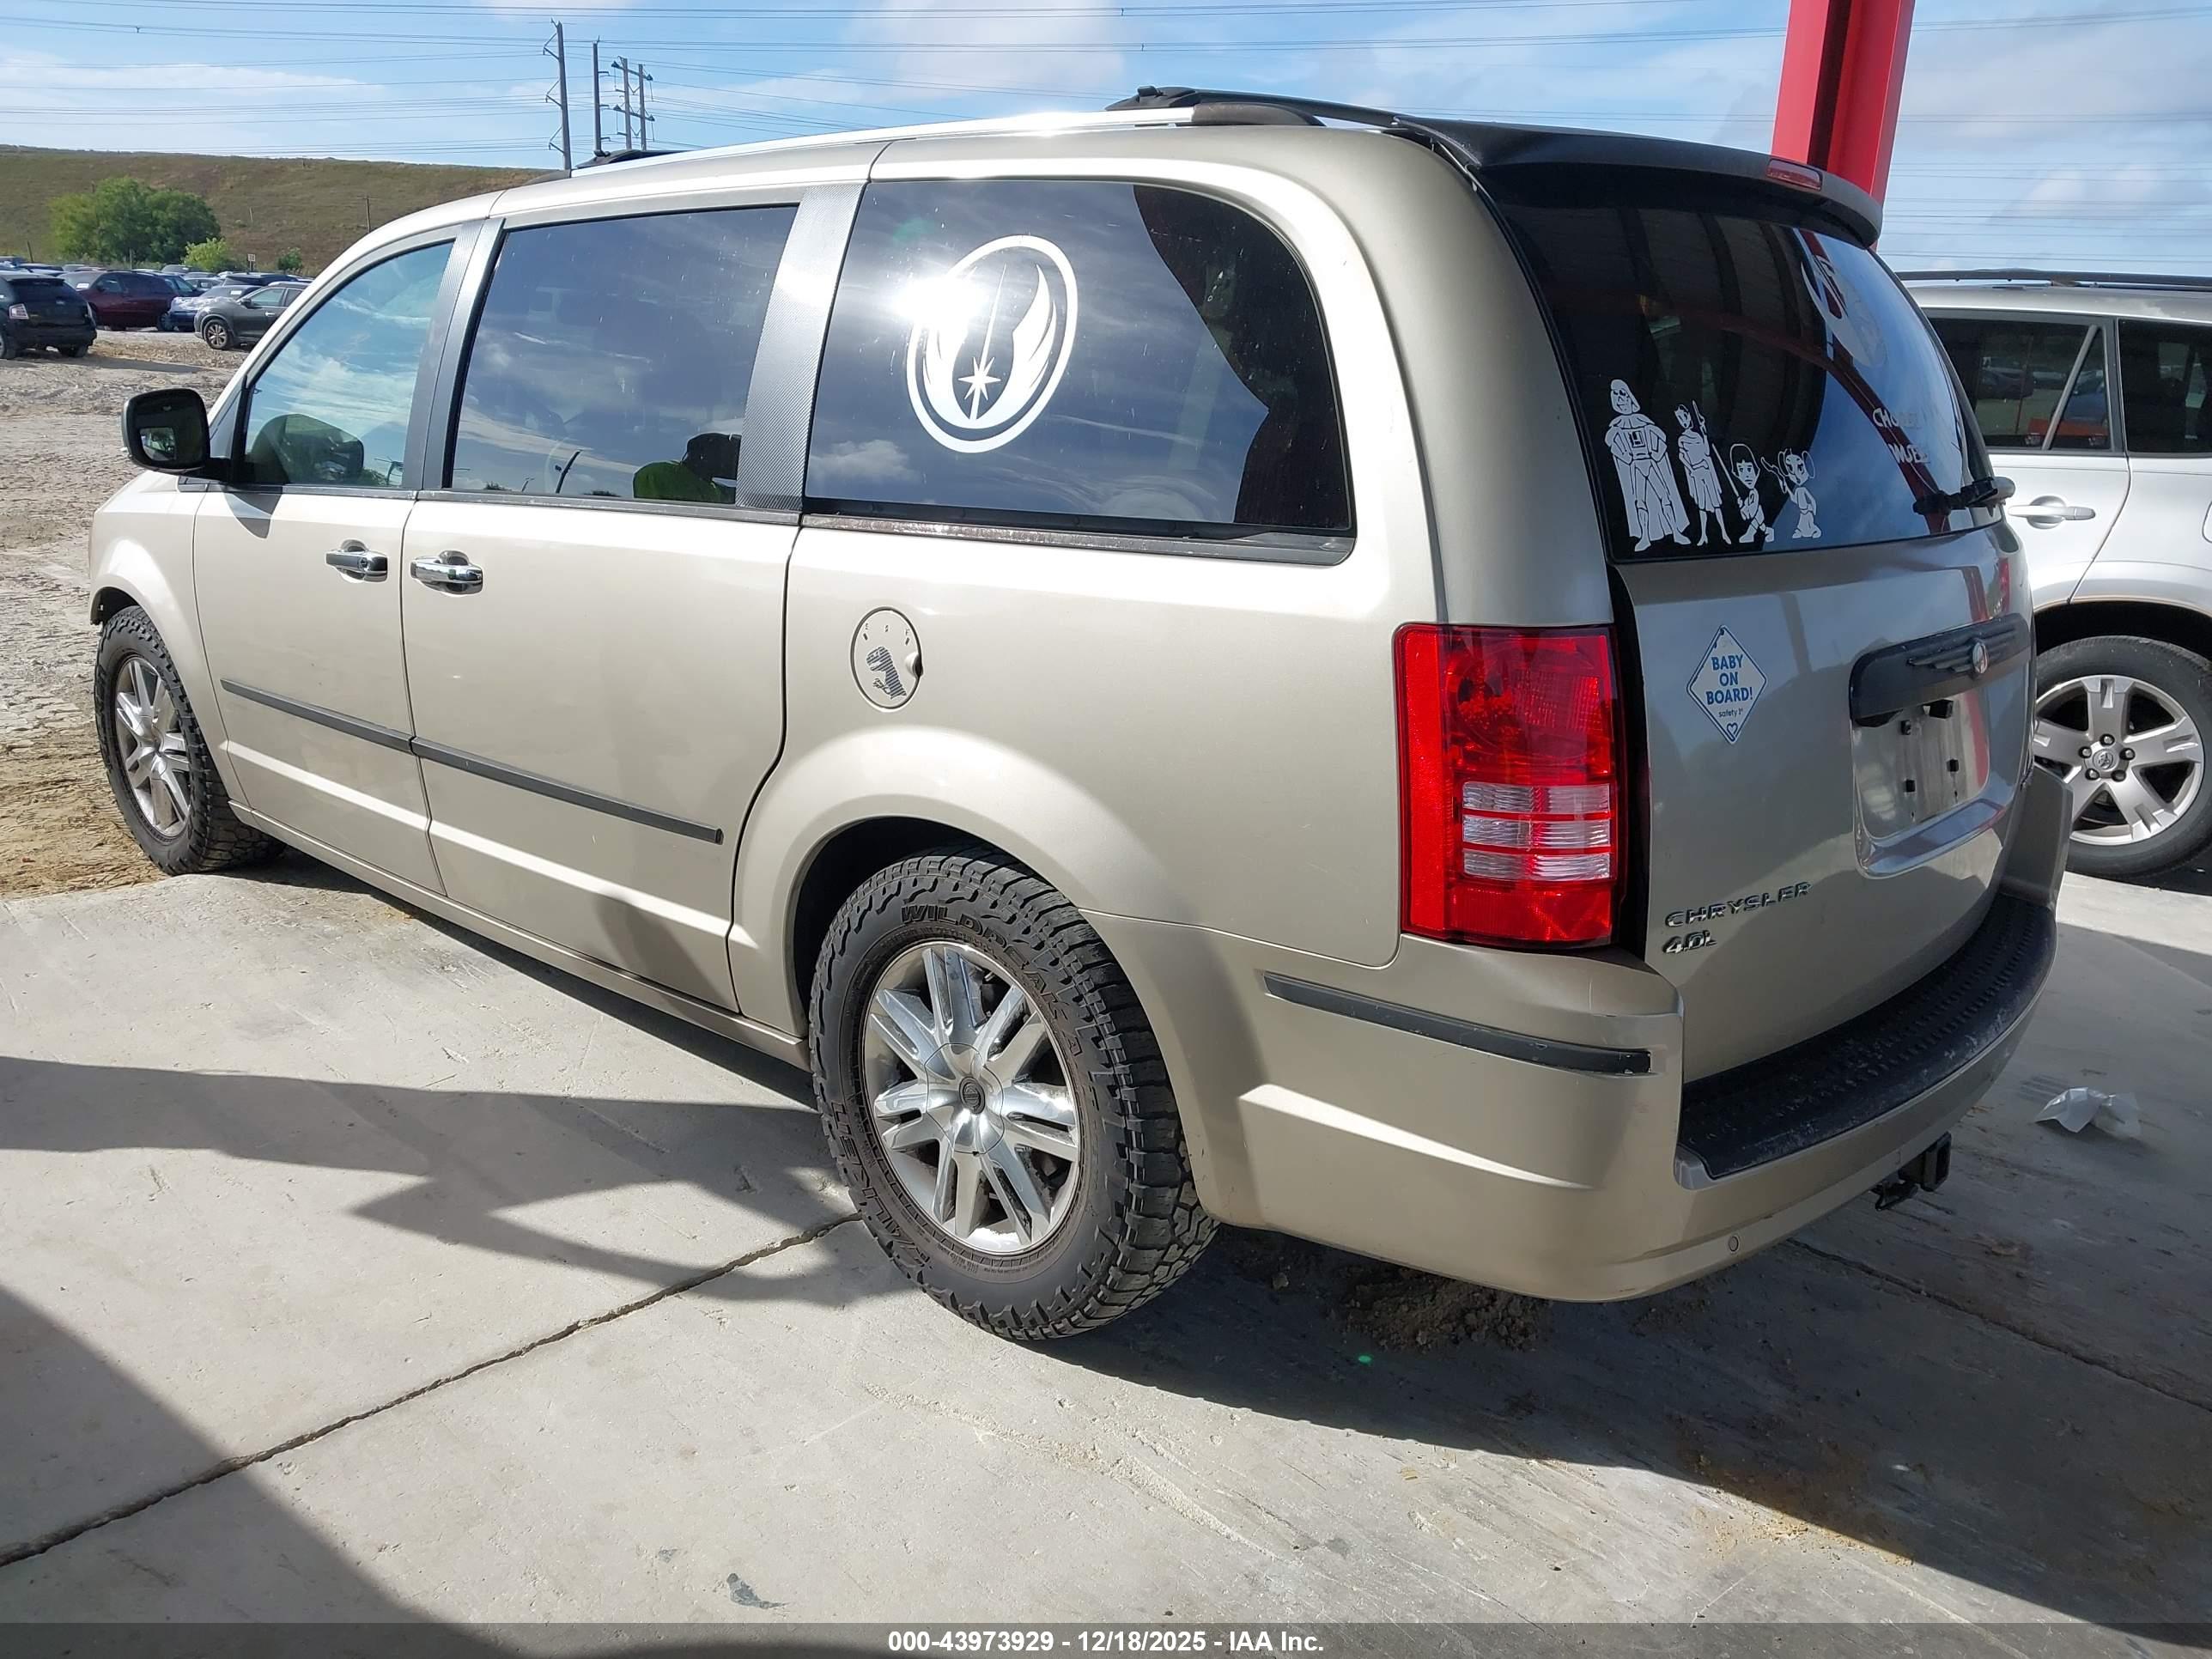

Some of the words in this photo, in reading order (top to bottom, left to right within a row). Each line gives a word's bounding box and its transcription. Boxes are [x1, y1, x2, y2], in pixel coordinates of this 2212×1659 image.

[1711, 653, 1744, 672] BABY
[1719, 672, 1739, 687] ON
[1705, 686, 1753, 706] BOARD!
[1718, 708, 1737, 718] safety
[1664, 880, 1814, 928] CHRYSLER
[1662, 929, 1718, 954] 4.0L
[900, 903, 1070, 1022] WILDPEAK
